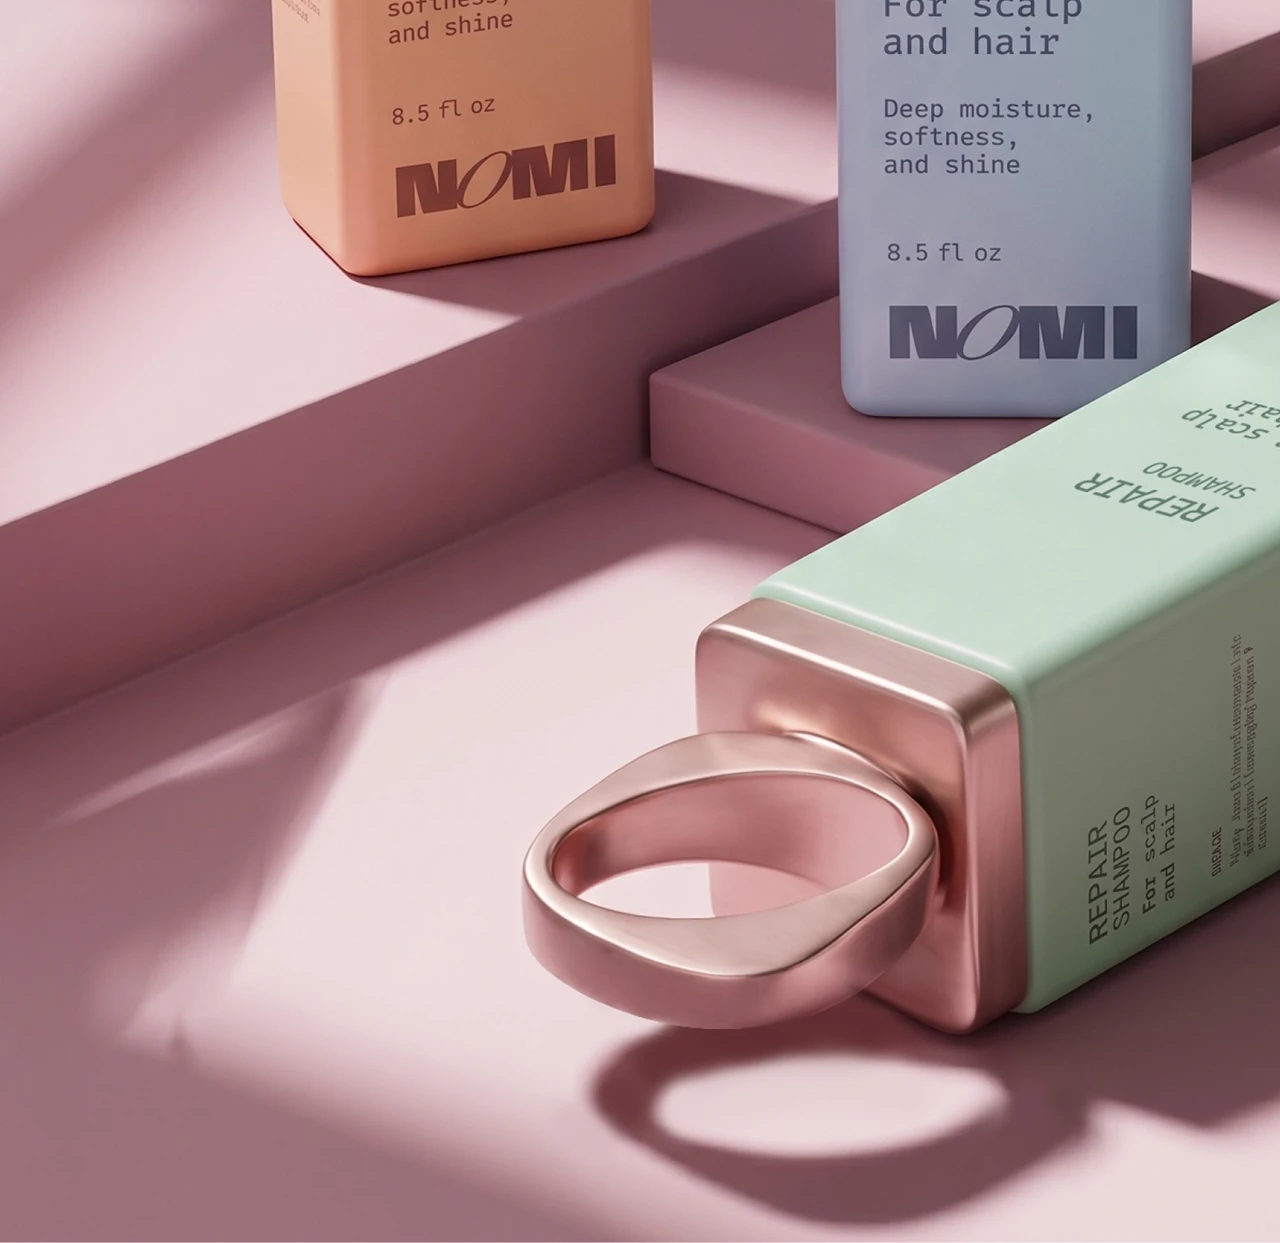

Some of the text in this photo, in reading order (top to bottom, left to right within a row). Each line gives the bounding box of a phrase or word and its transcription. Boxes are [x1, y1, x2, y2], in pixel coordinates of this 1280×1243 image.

[388, 12, 513, 44] and shine
[883, 26, 1060, 55] and hair
[392, 97, 496, 126] 8.5 fl oz
[883, 97, 1094, 123] Deep moisture,
[884, 125, 1018, 151] softness,
[395, 133, 617, 219] NOMI
[884, 153, 1021, 174] and shine
[887, 242, 1002, 262] 8.5 fl oz
[889, 304, 1138, 360] NOMI
[1181, 407, 1270, 440] scalp
[1073, 472, 1220, 523] REPAIR
[1142, 461, 1257, 500] SHAMPOO
[1112, 805, 1131, 930] SHAMPOO
[1140, 794, 1160, 913] For scalp
[1159, 802, 1175, 901] and hair
[1088, 819, 1108, 944] REPAIR
